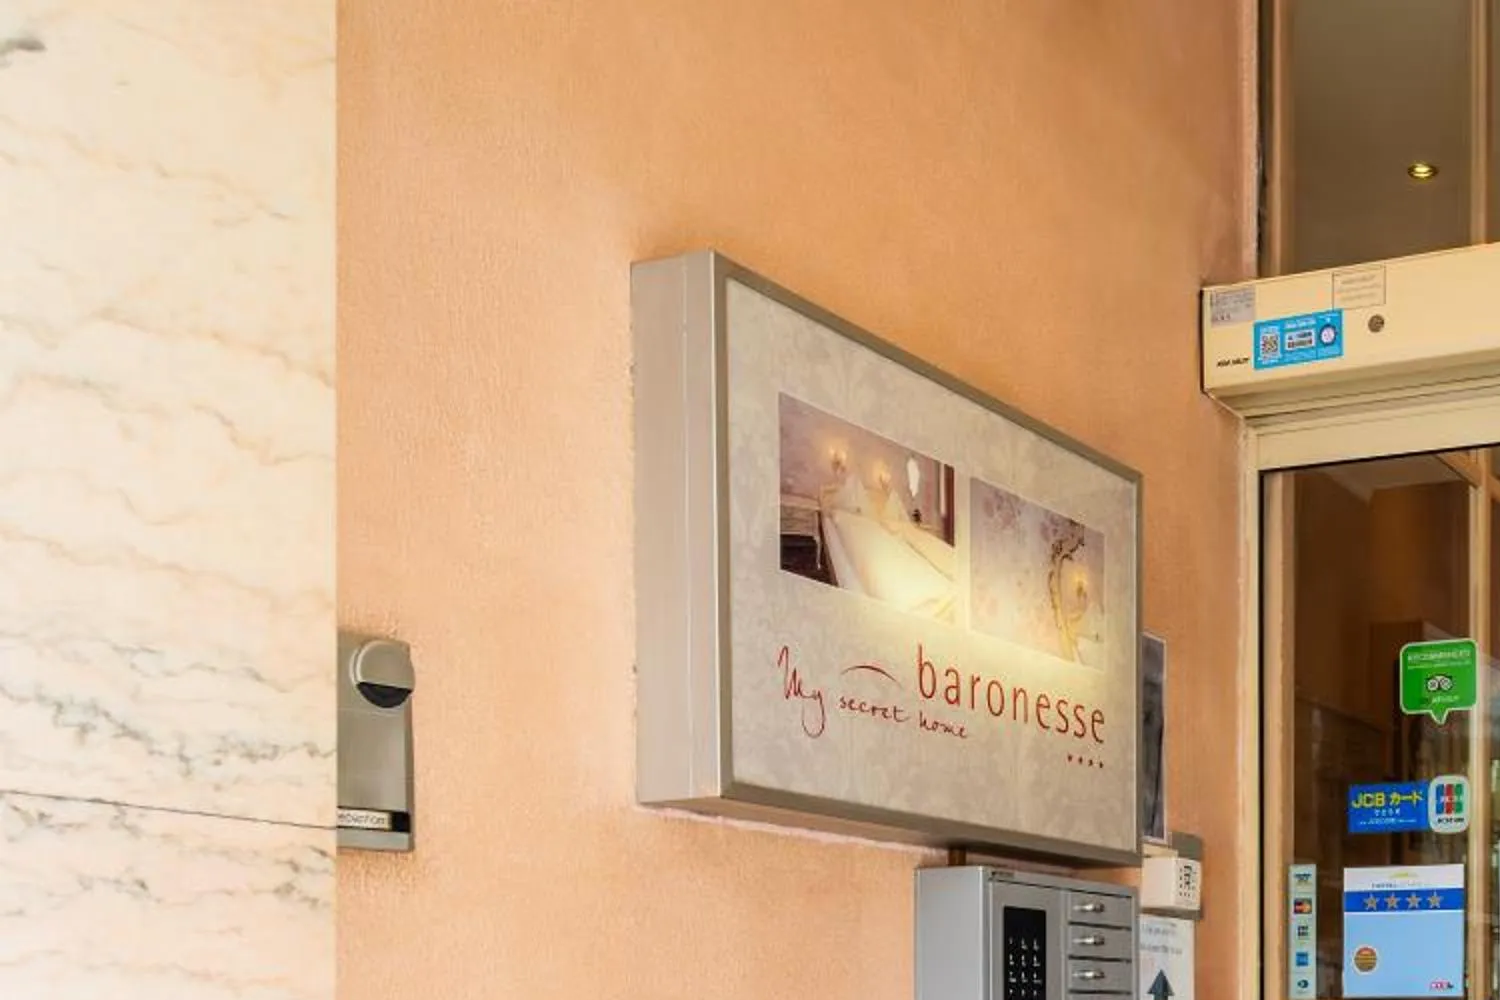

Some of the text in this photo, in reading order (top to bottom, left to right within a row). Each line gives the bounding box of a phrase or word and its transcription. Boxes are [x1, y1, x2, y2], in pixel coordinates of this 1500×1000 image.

[778, 645, 970, 740] My secret home
[917, 643, 1105, 743] baronesse
[1352, 789, 1424, 809] JCB カード
